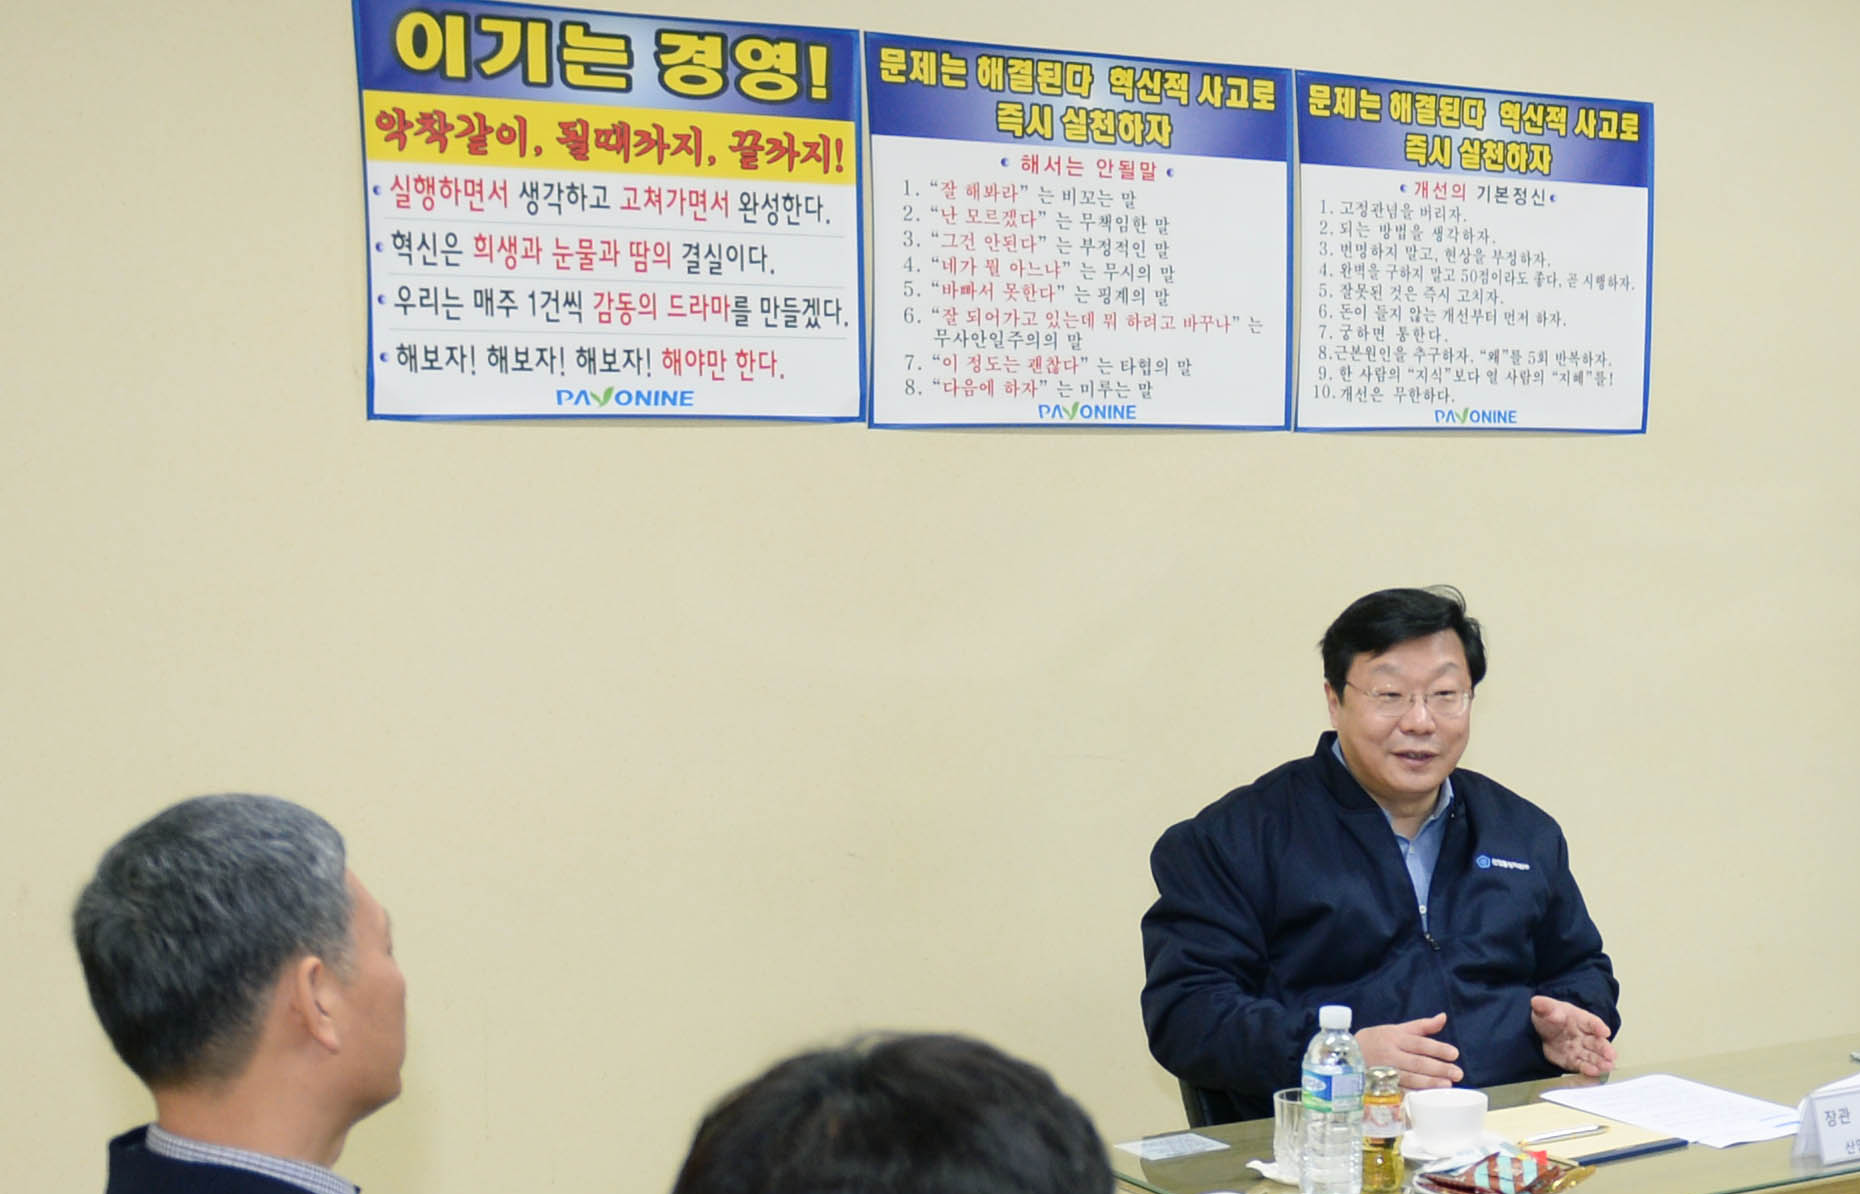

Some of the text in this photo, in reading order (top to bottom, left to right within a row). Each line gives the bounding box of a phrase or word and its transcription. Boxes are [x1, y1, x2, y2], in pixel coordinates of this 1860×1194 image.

[395, 11, 832, 102] 이기는 경영!
[879, 47, 1277, 112] 문제는 해결된다 혁신적 사고로
[996, 102, 1172, 148] 즉시 실천하자
[1308, 84, 1640, 142] 문제는 해결된다 혁신적 사고로
[375, 108, 845, 174] 악착같이, 될때까지, 끝까지!
[1404, 132, 1552, 174] 즉시 실천하자
[1021, 154, 1083, 176] 해서는
[390, 175, 830, 226] 실행하면서 생각하고 고쳐가면서 완성한다.
[904, 180, 1136, 209] 1. 는 비꼬는 말
[1415, 181, 1545, 206] 개선의 기본정신
[903, 205, 920, 221] 2.
[1056, 212, 1072, 230] 는
[1080, 213, 1147, 234] 무책임한
[1155, 217, 1169, 235] 말
[392, 230, 774, 275] 혁신은 희생과 눈물과 땀의 결실이다.
[903, 230, 920, 247] 3.
[1056, 236, 1072, 255] 는
[1080, 238, 1145, 258] 부정적인
[1155, 240, 1169, 259] 말
[904, 256, 1175, 283] 4. 는 무시의 말
[394, 286, 848, 328] 우리는 매주 1건씩 감동의 드라마를 만들겠다.
[904, 280, 920, 297] 5.
[1075, 286, 1090, 304] 는
[1155, 288, 1169, 307] 말
[904, 307, 921, 323] 6.
[967, 308, 1037, 328] 되어가고
[1046, 310, 1094, 328] 있는데
[1127, 312, 1176, 331] 하려고
[1248, 316, 1263, 334] 는
[934, 329, 1082, 351] 무사안일주의의 말
[396, 344, 784, 381] 해보자! 해보자! 해보자! 해야만 한다.
[905, 354, 1192, 376] 7. 정도는 는 타협의 말
[556, 386, 694, 408] PAVONINE
[905, 379, 1152, 399] 8. 는 미루는 말
[1038, 401, 1136, 420] PAVONINE
[1434, 408, 1517, 424] PAVONINE
[1824, 1107, 1851, 1128] 장관
